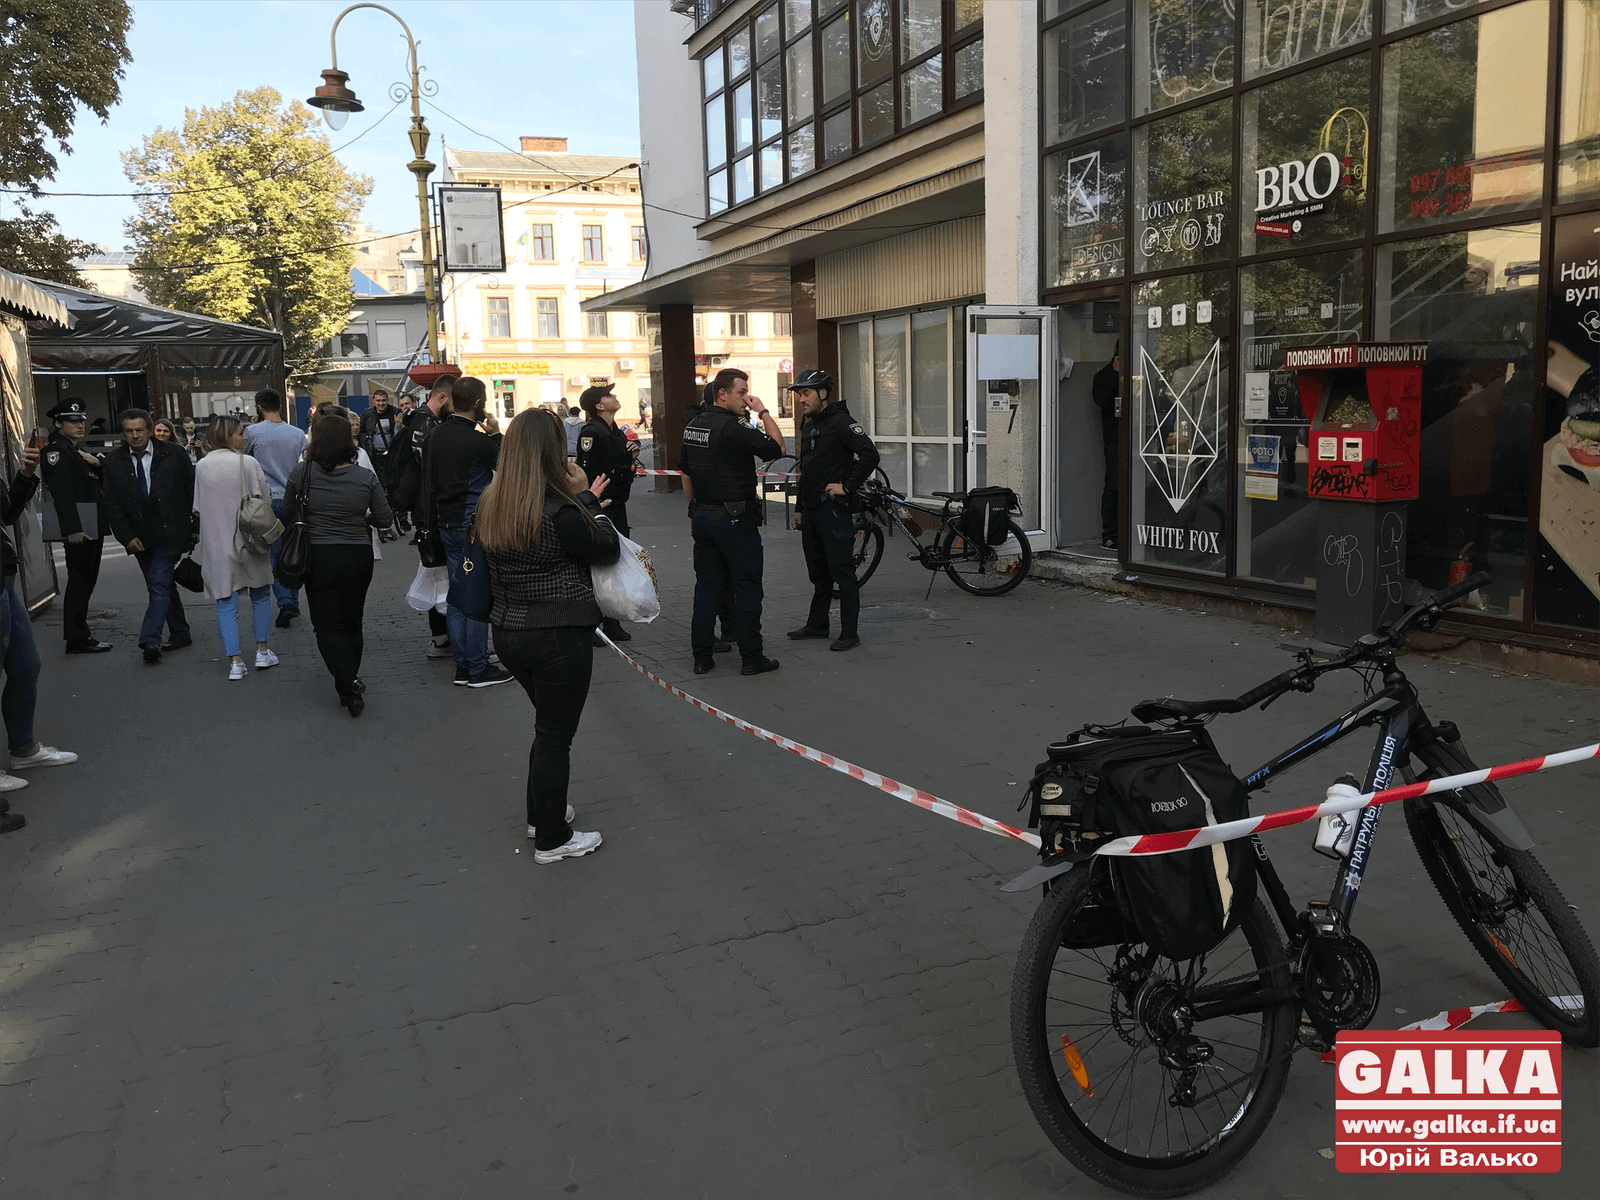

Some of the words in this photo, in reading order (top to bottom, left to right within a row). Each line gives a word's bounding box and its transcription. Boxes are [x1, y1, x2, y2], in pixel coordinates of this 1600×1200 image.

[1140, 196, 1193, 222] LOUNGE
[1196, 190, 1225, 211] BAR
[1260, 214, 1280, 223] Creative
[1280, 208, 1305, 219] Marketing
[1310, 203, 1324, 212] SMM
[1077, 241, 1122, 264] DESIGN
[1560, 260, 1600, 282] Най
[1566, 286, 1600, 307] вул
[1286, 346, 1332, 367] ПОПОВНЮЙ
[1333, 347, 1352, 364] ТУТ!
[1357, 344, 1410, 363] ПОПОВНЮЙ
[1412, 345, 1428, 361] ТУТ
[683, 429, 710, 444] ПОЛІЦІЯ
[1251, 447, 1274, 457] ФОТО
[1136, 524, 1185, 550] WHITE
[1188, 530, 1220, 554] FOX
[1373, 735, 1397, 790] ПОЛІЦІЯ
[1246, 766, 1271, 786] ATX
